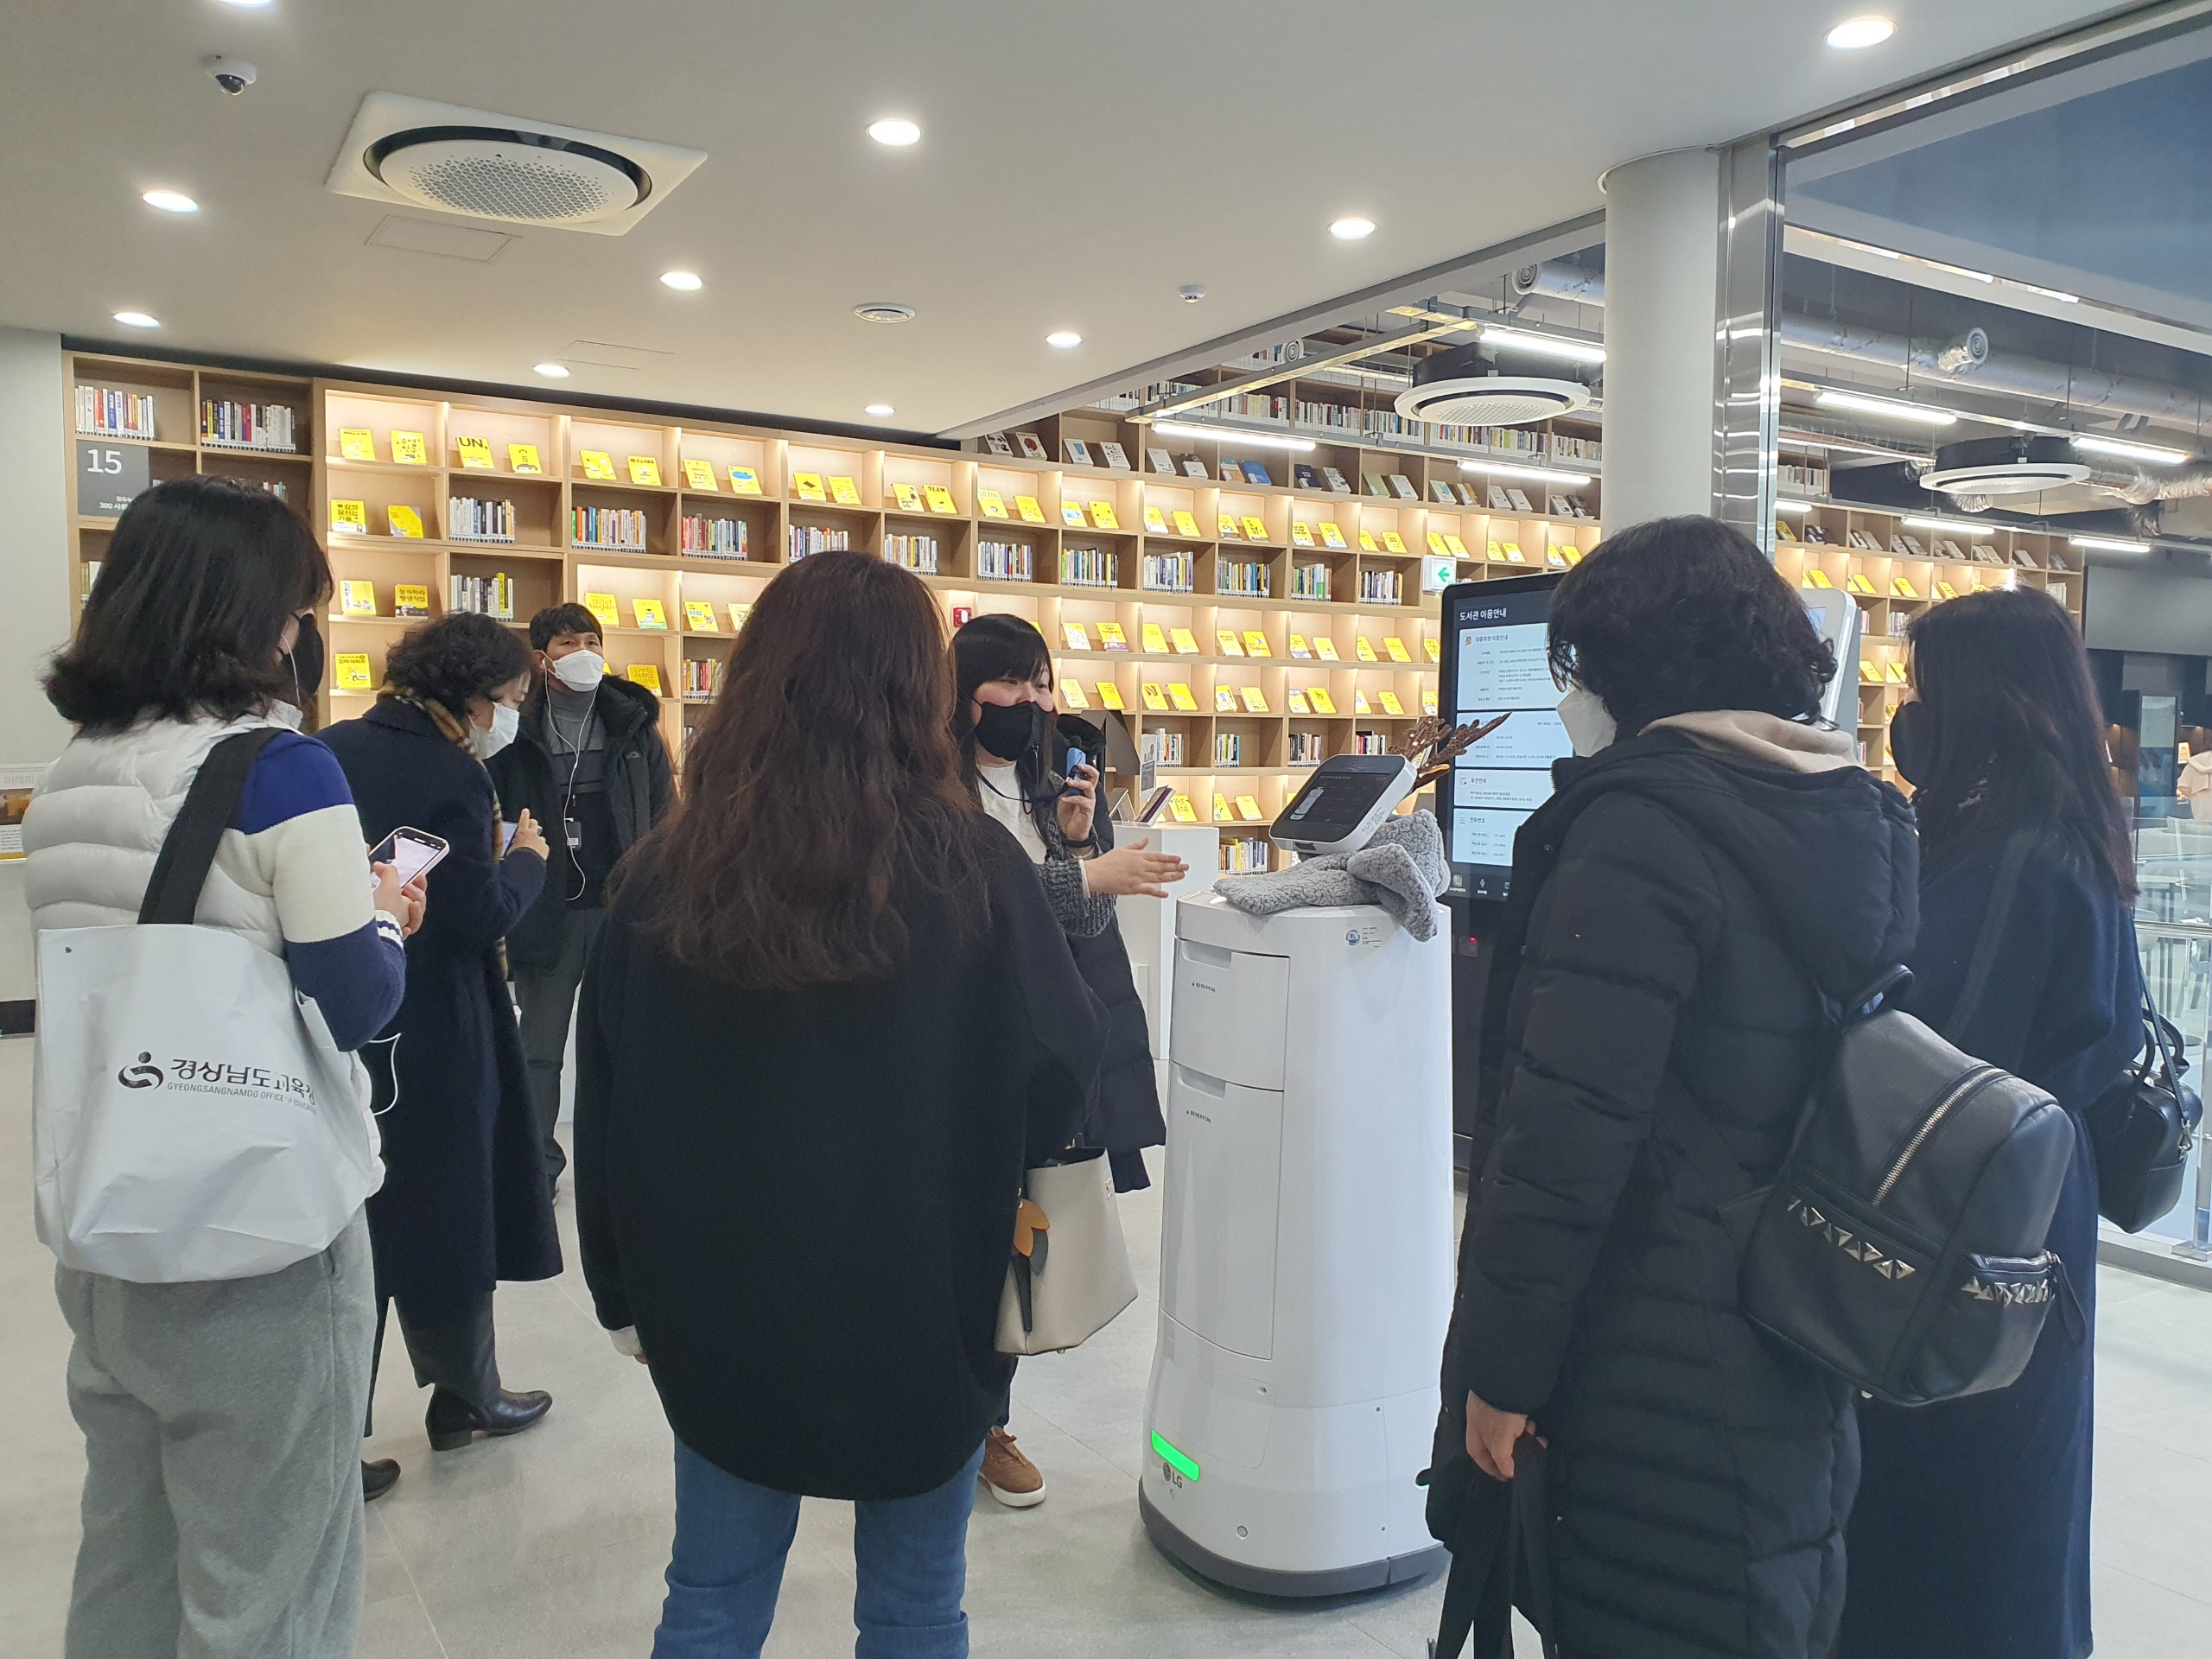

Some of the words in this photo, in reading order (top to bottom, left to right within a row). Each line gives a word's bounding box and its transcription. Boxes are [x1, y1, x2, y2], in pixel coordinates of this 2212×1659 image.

[87, 448, 122, 474] 15
[1459, 610, 1479, 621] 도서관
[1480, 607, 1507, 620] 이용안내
[167, 1082, 258, 1098] GYEONGSANGNAMDO
[260, 1090, 284, 1102] OFFICE
[1172, 1471, 1183, 1489] LG
